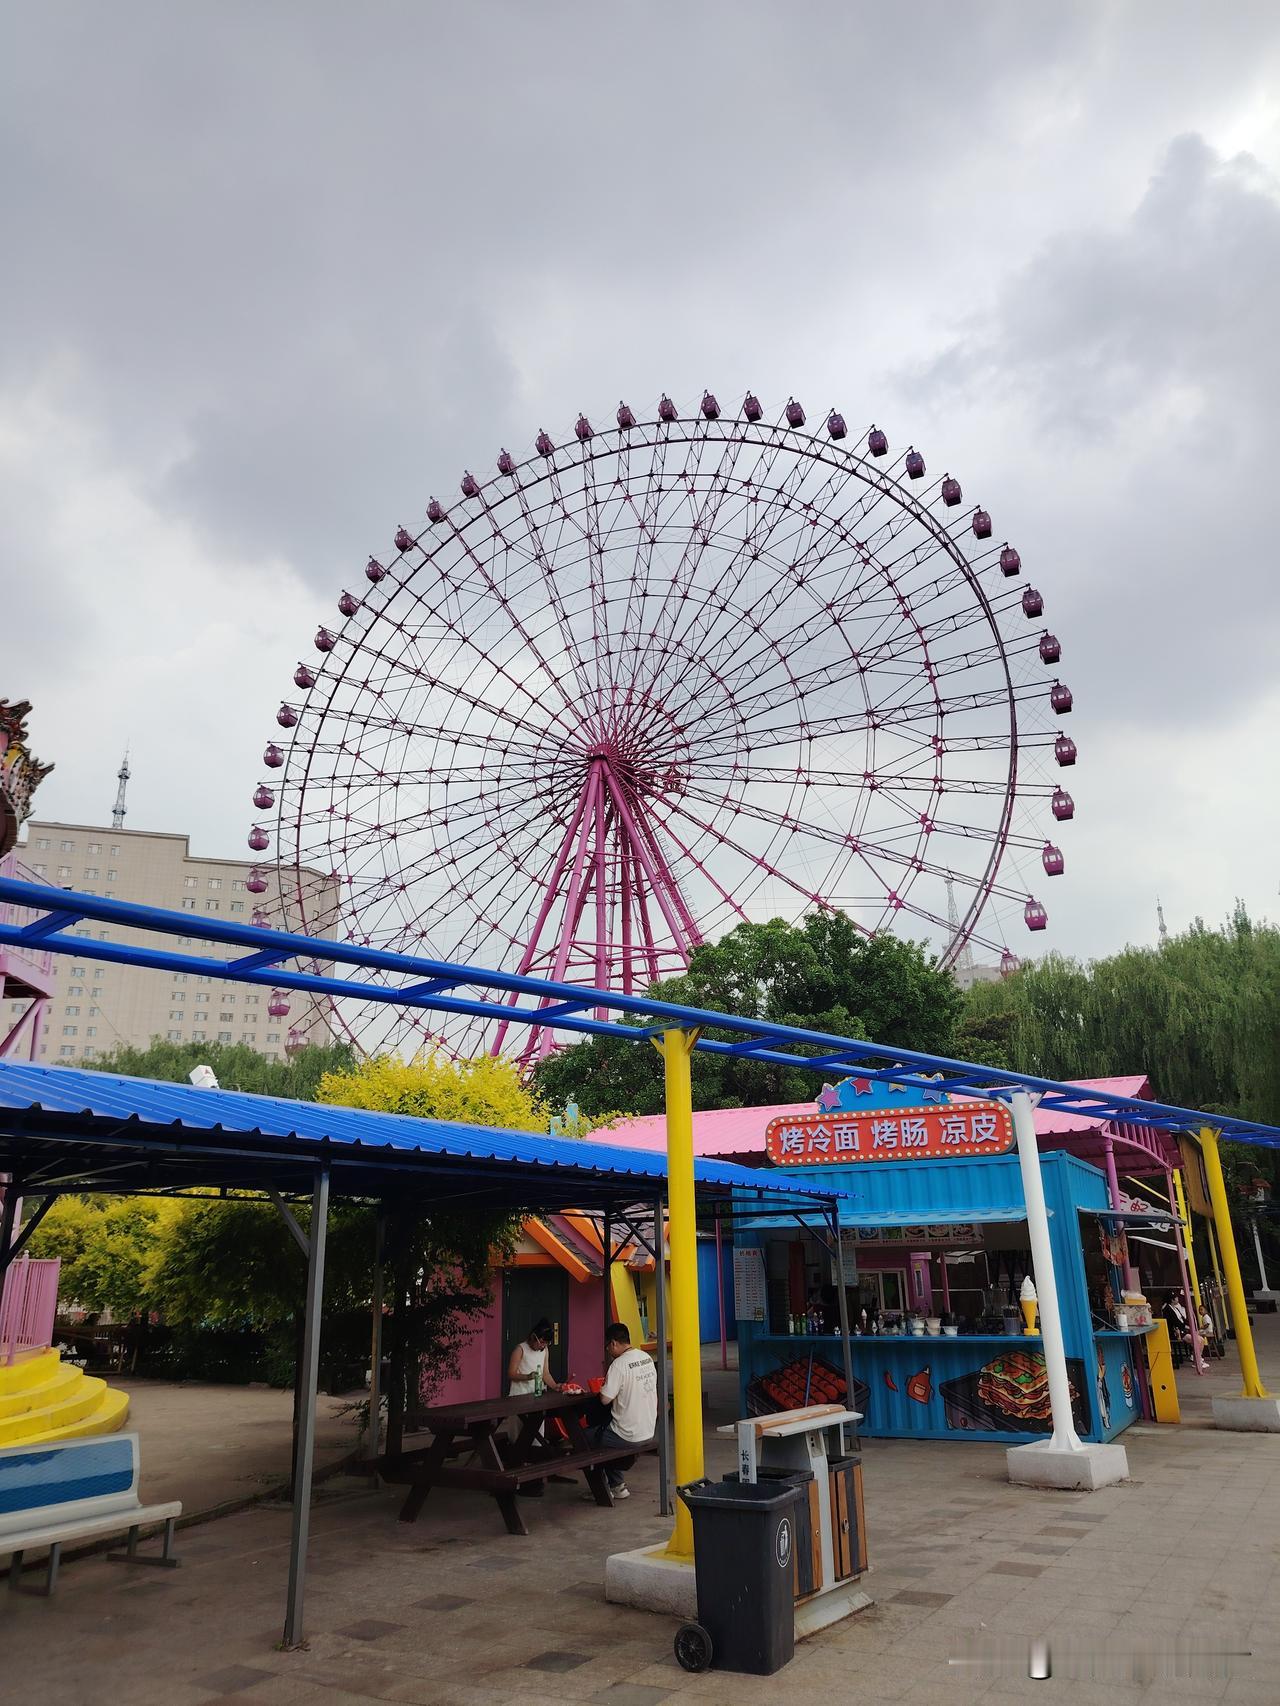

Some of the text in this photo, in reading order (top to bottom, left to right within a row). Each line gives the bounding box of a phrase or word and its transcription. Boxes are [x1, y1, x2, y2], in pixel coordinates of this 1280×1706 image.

[780, 1112, 1000, 1155] 烤冷面 烤肠 凉皮
